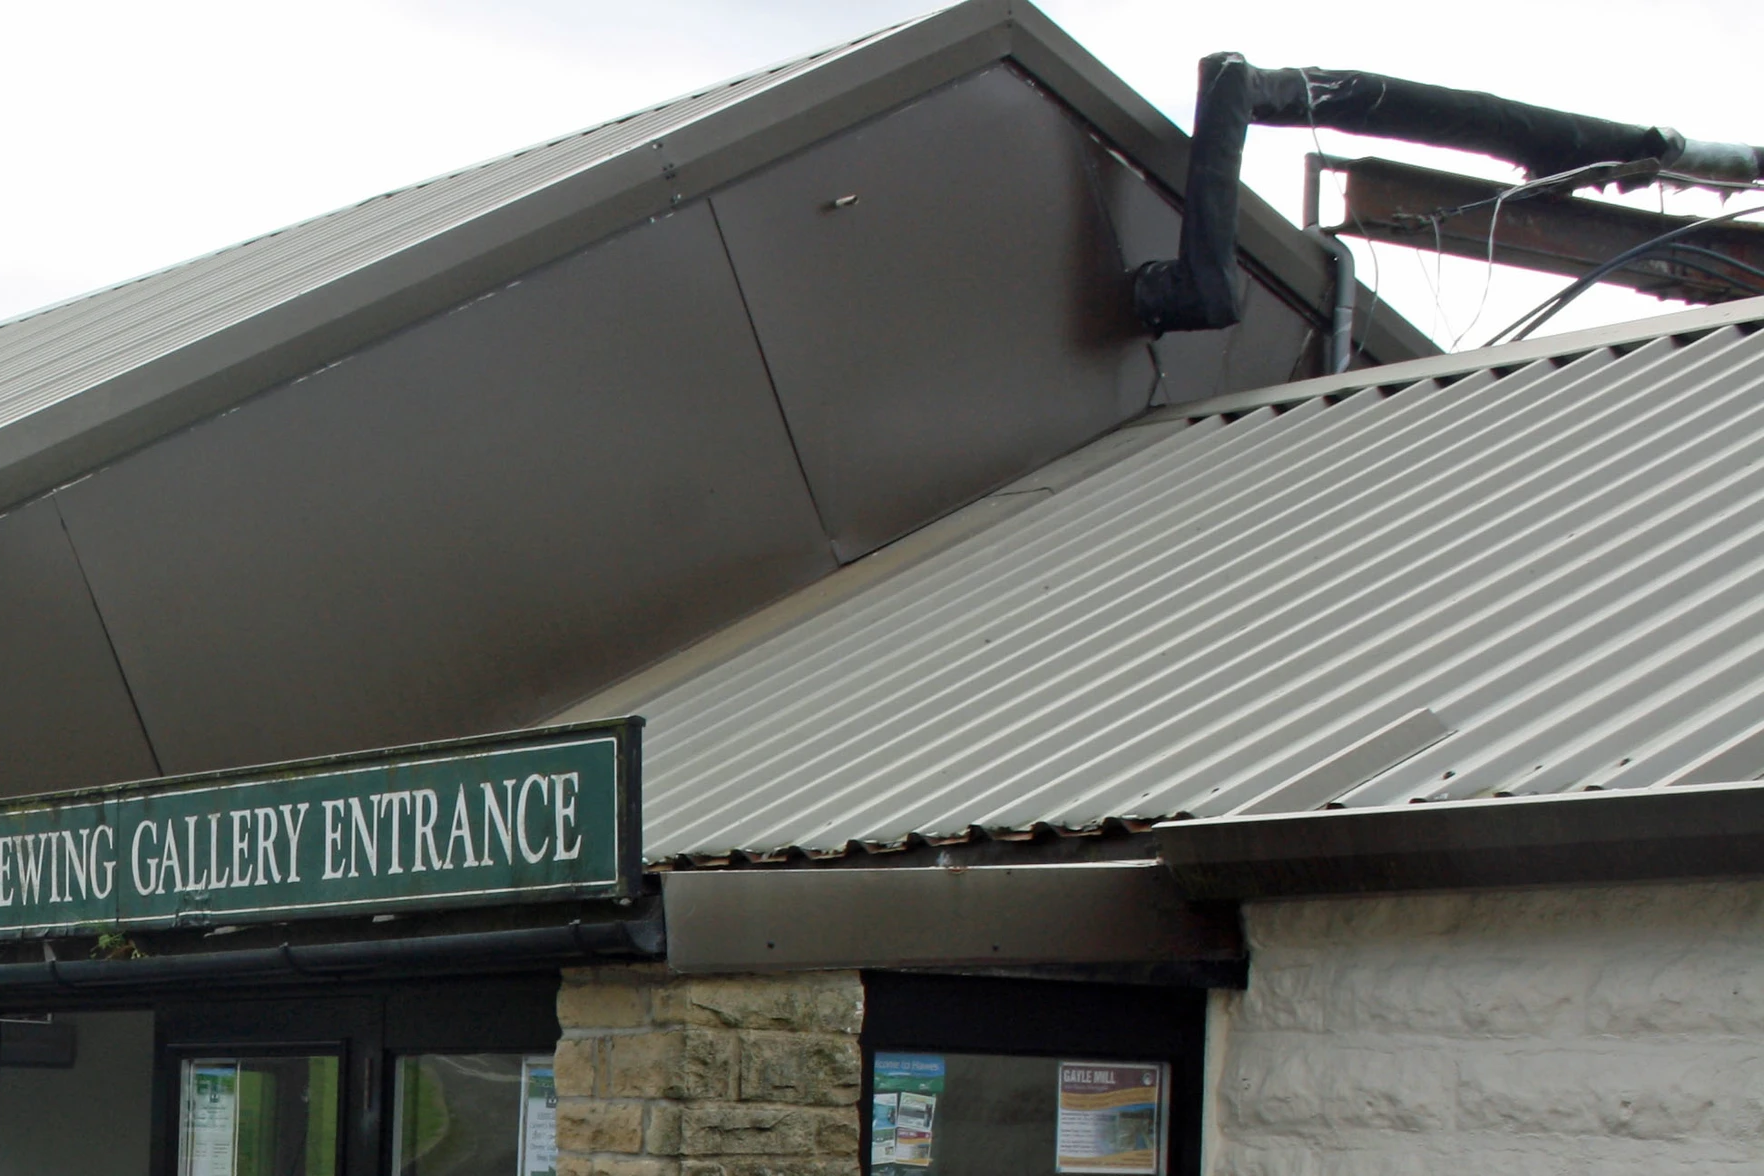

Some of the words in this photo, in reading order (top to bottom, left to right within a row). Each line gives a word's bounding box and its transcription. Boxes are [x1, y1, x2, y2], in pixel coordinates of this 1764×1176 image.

[131, 801, 310, 897] GALLERY
[322, 771, 581, 881] ENTRANCE
[1064, 1070, 1092, 1083] GAYLE
[1093, 1071, 1116, 1084] MILL
